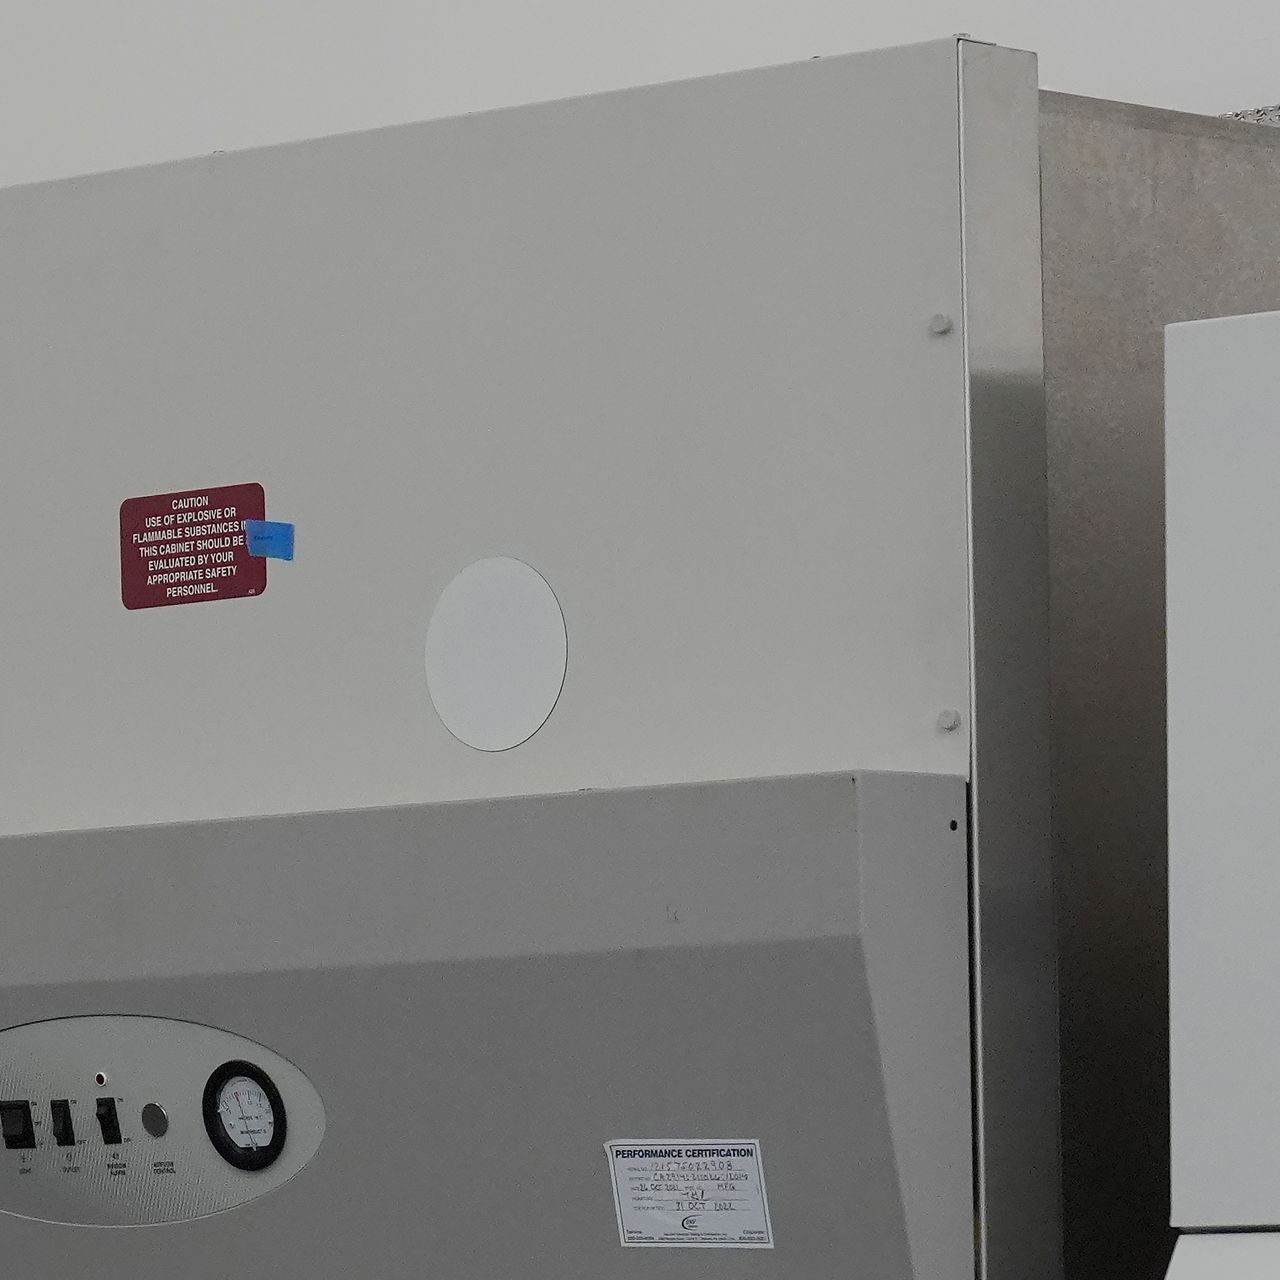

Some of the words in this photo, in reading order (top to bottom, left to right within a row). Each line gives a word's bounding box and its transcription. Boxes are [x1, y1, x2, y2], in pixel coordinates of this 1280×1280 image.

[172, 496, 209, 510] CAUTION
[145, 515, 162, 528] USE
[164, 514, 175, 526] OF
[177, 508, 222, 524] EXPLOSIVE
[224, 507, 236, 518] OR
[132, 527, 183, 544] FLAMMABLE
[184, 521, 239, 538] SUBSTANCES
[139, 544, 158, 557] THIS
[159, 541, 195, 555] CABINET
[196, 537, 231, 551] SHOULD
[232, 535, 244, 546] BE
[148, 556, 196, 571] EVALUATED
[198, 553, 209, 565] BY
[210, 551, 234, 564] YOUR
[146, 569, 203, 586] APPROPRIATE
[205, 565, 238, 579] SAFETY
[166, 582, 219, 598] PERSONNEL.
[615, 1149, 683, 1159] PERFORMANCE
[685, 1148, 754, 1159] CERTIFICATION
